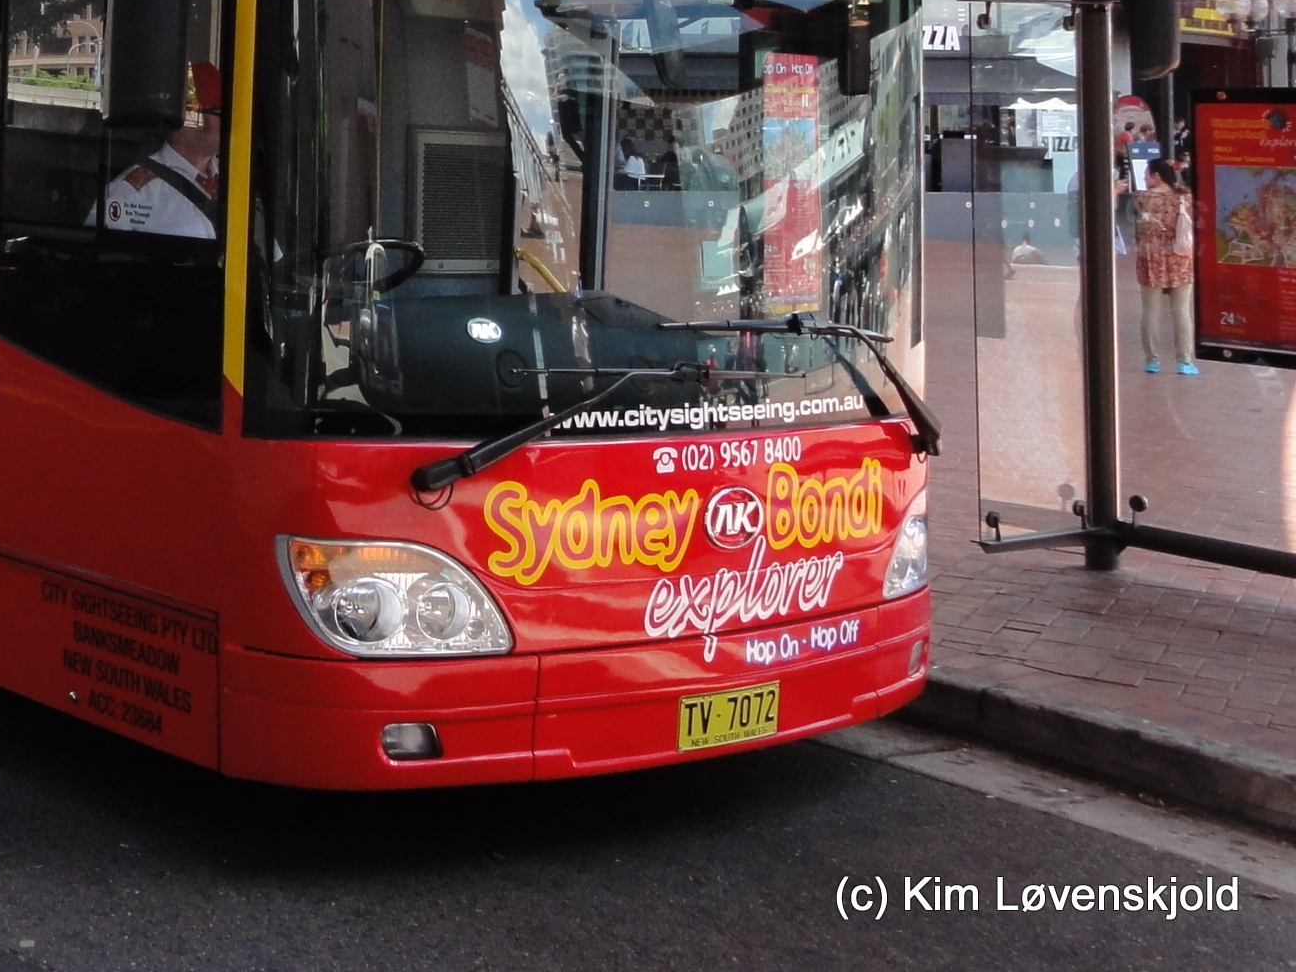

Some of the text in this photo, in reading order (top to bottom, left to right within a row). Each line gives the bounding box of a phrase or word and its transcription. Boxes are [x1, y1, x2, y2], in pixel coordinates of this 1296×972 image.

[776, 63, 787, 74] On
[681, 436, 802, 471] (02) 9567 8400
[484, 458, 884, 586] Sydney Bondi
[41, 580, 219, 655] CITY SIGHTSEEING PTY LTD
[644, 536, 843, 662] explorer
[73, 619, 181, 676] BANKSMEADOW
[746, 619, 860, 665] Hop On Hop Off
[62, 649, 192, 715] NEW SOUTH WALES
[684, 689, 776, 736] TV 7072
[691, 726, 767, 747] NEW SOUTH WALES
